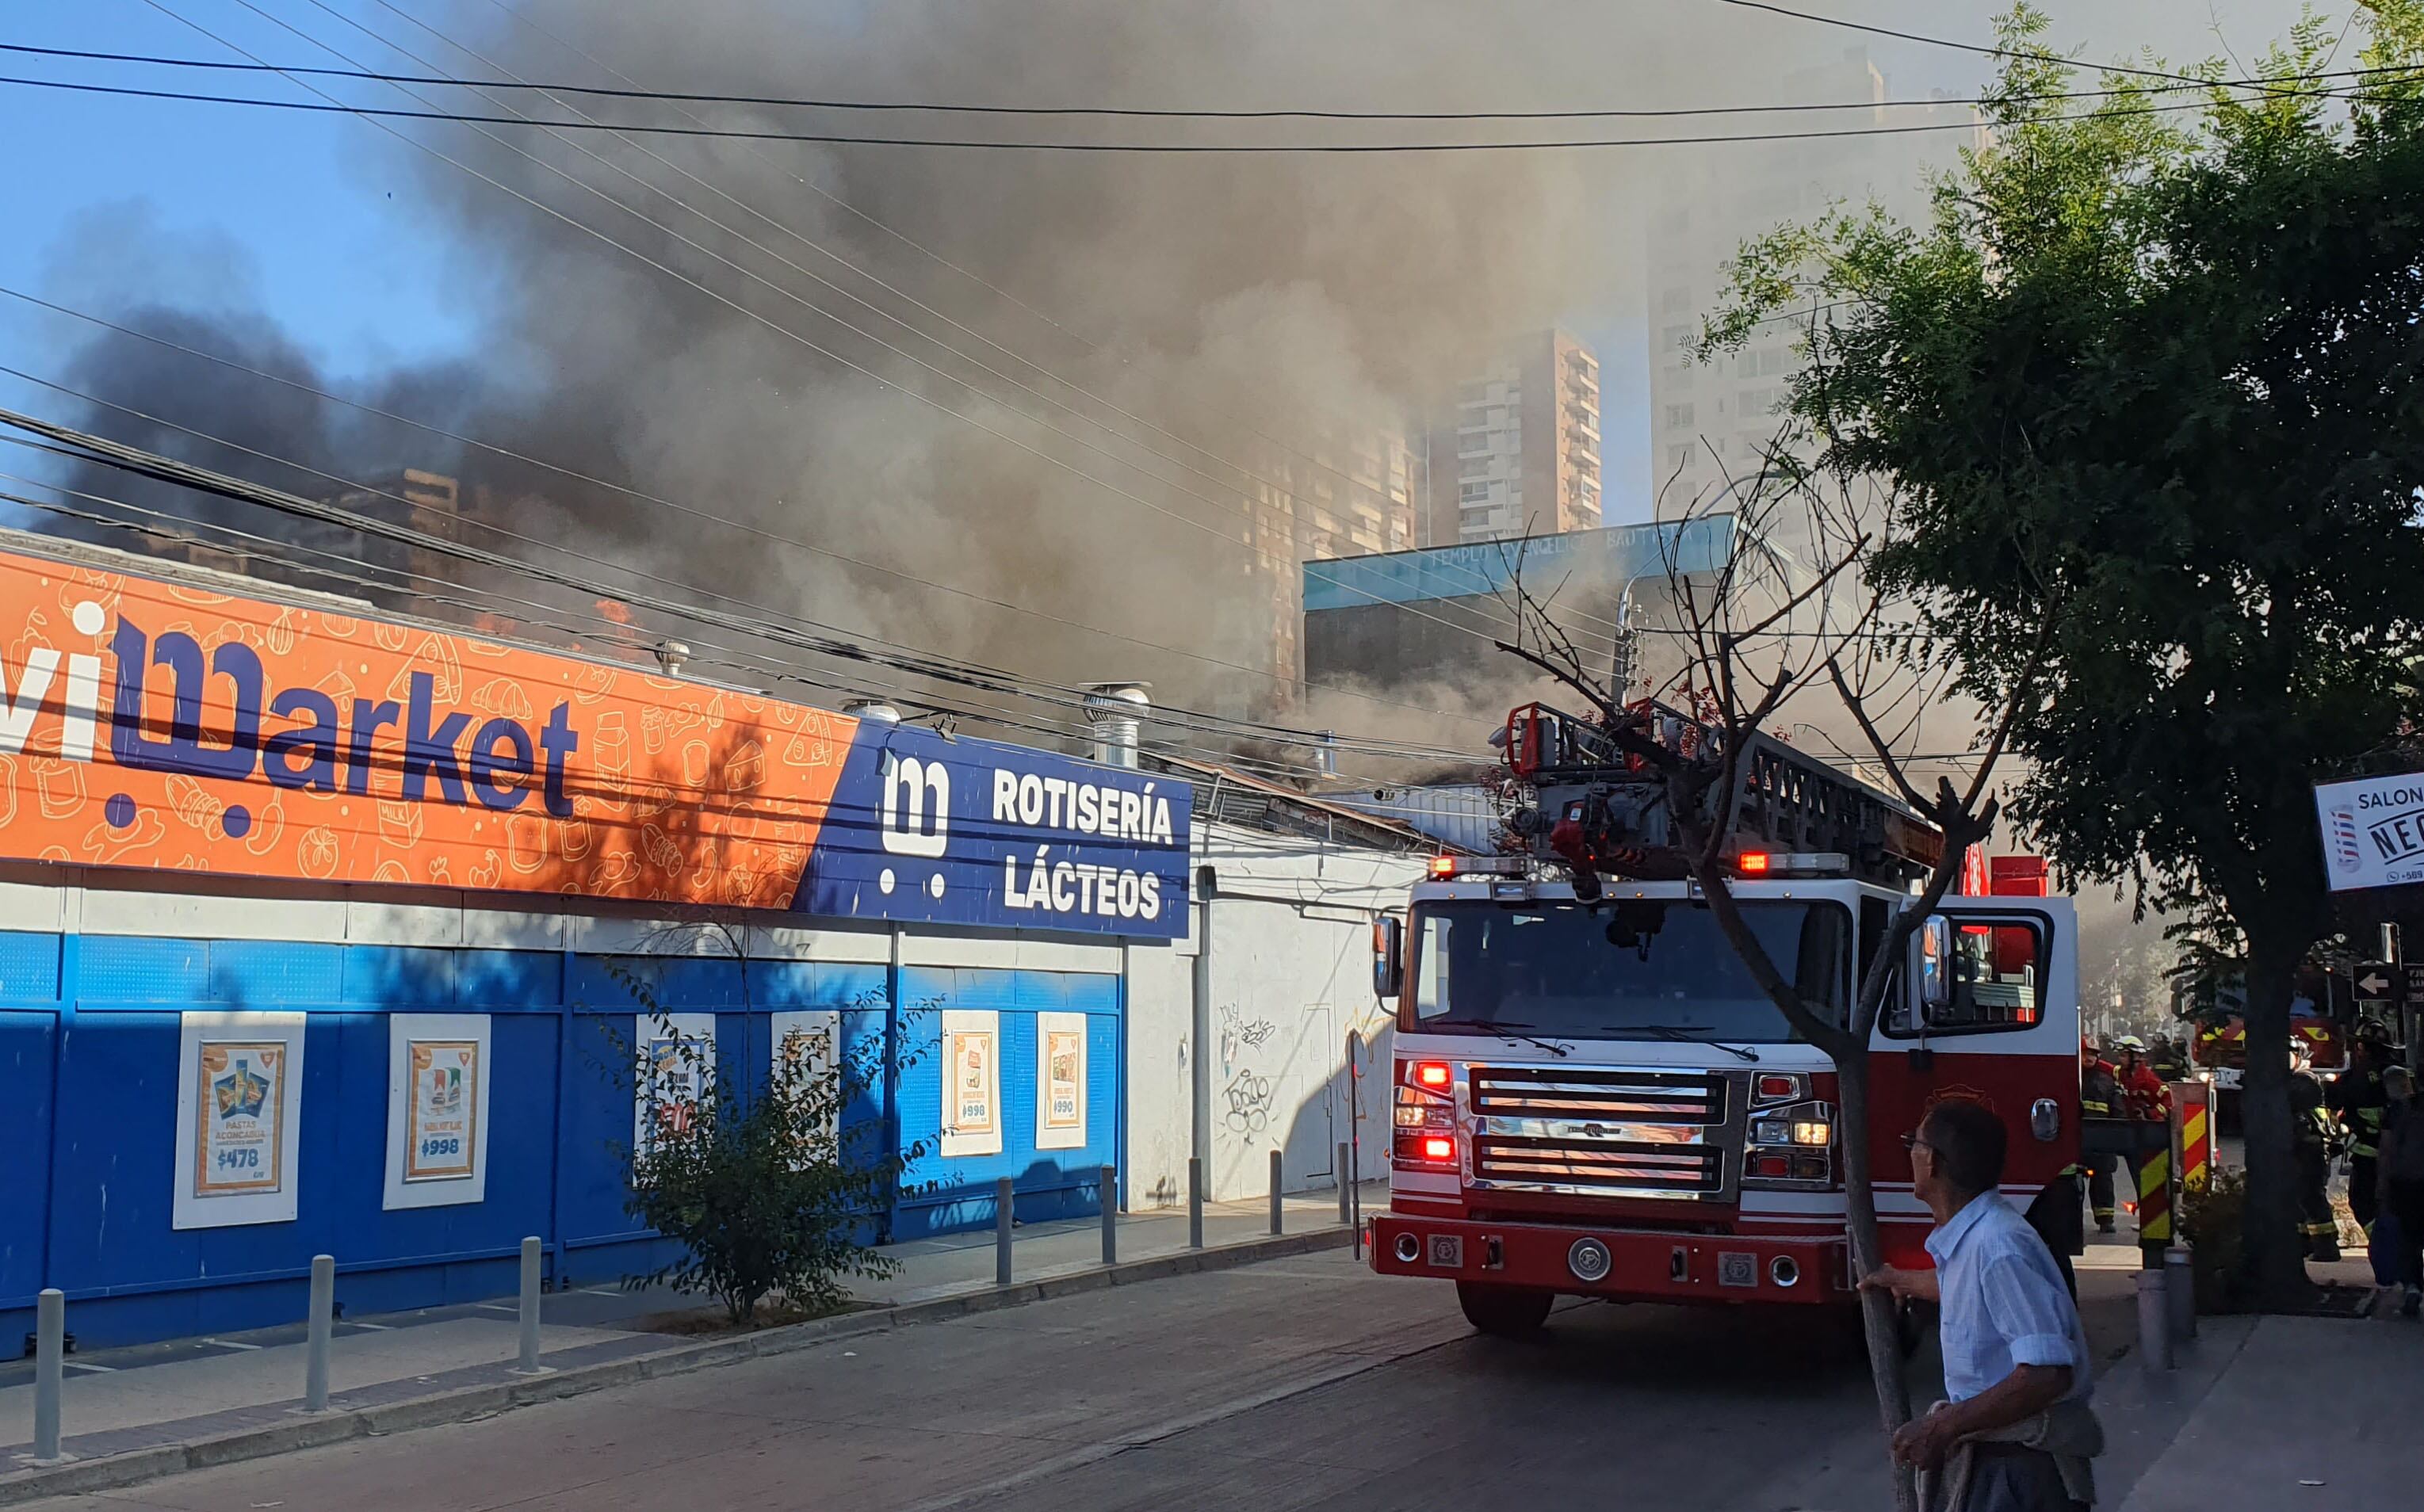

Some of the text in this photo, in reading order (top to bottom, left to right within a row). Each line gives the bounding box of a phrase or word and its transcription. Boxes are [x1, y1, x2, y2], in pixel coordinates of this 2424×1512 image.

[1429, 544, 1489, 567] TEMPLO
[992, 768, 1173, 846] ROTISERÍA
[2358, 787, 2424, 809] SALON
[381, 805, 406, 821] MILK
[1004, 845, 1160, 920] LÁCTEOS
[225, 1121, 256, 1129] PASTAS
[422, 1138, 459, 1157] $998
[218, 1147, 259, 1171] $478
